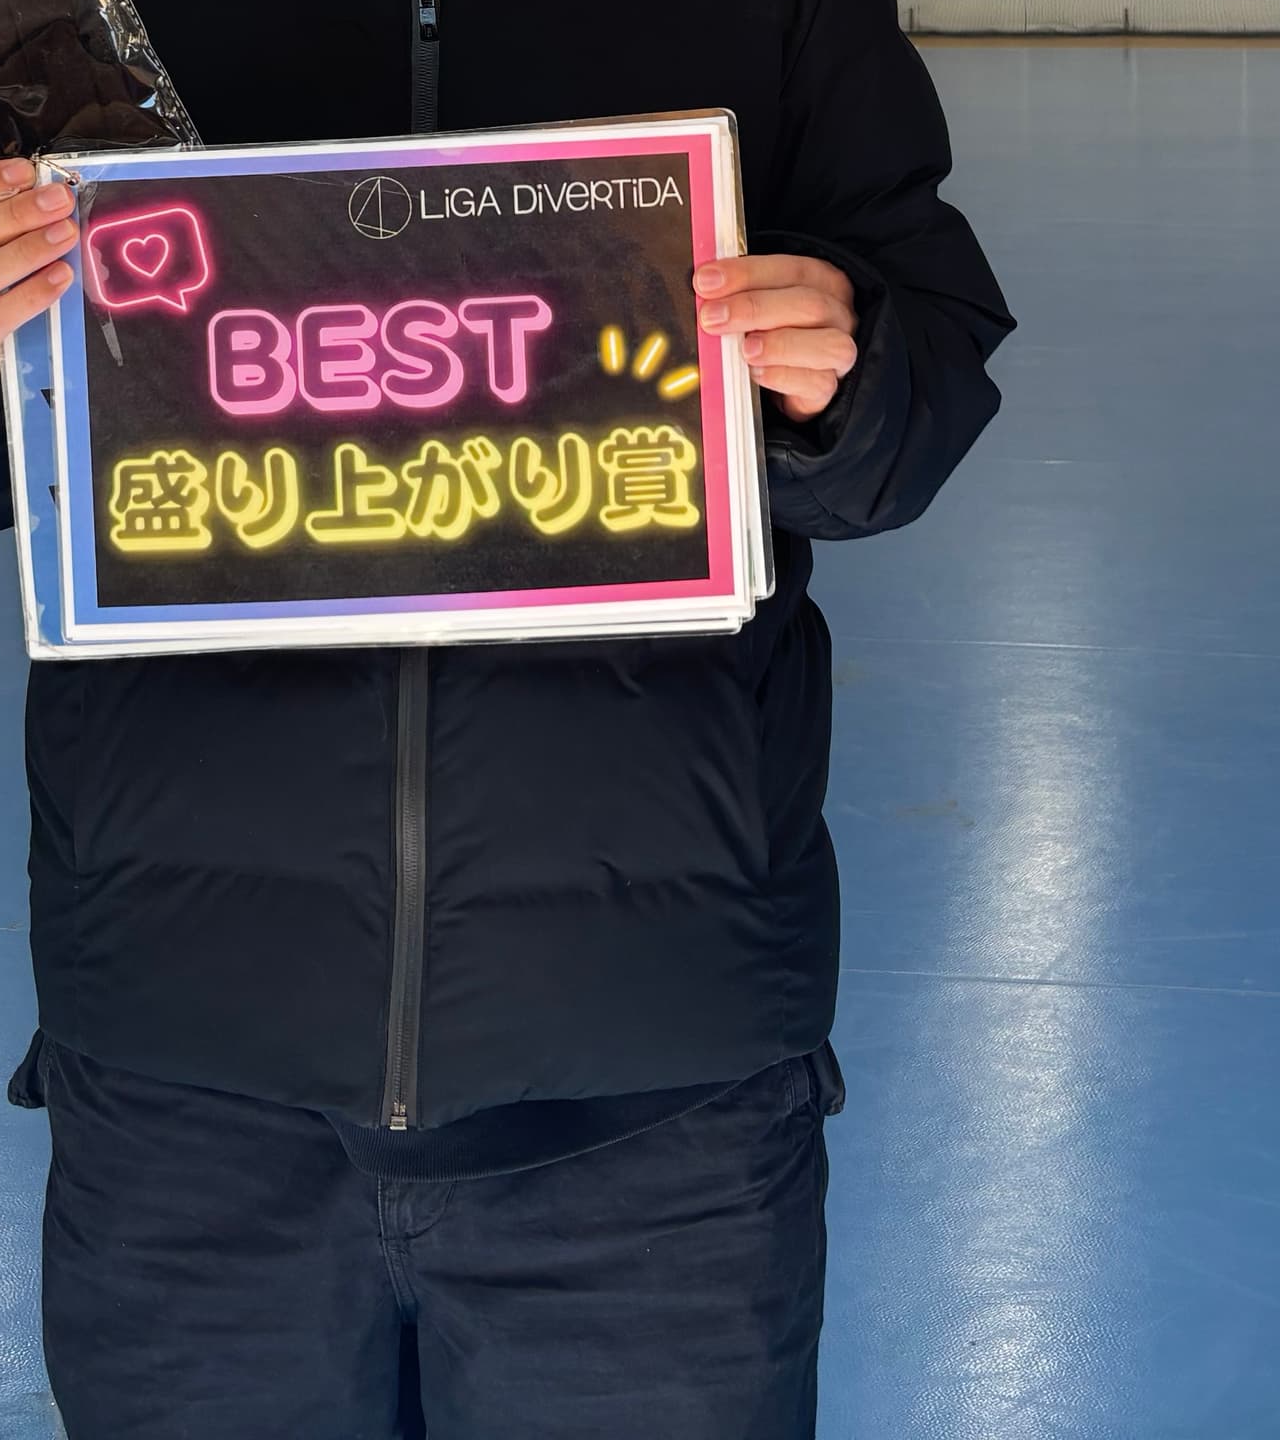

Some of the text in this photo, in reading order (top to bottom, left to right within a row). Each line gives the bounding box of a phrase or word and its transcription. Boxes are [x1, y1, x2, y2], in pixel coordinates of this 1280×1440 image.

[207, 294, 553, 415] BEST
[108, 424, 701, 551] 盛り上がり賞
